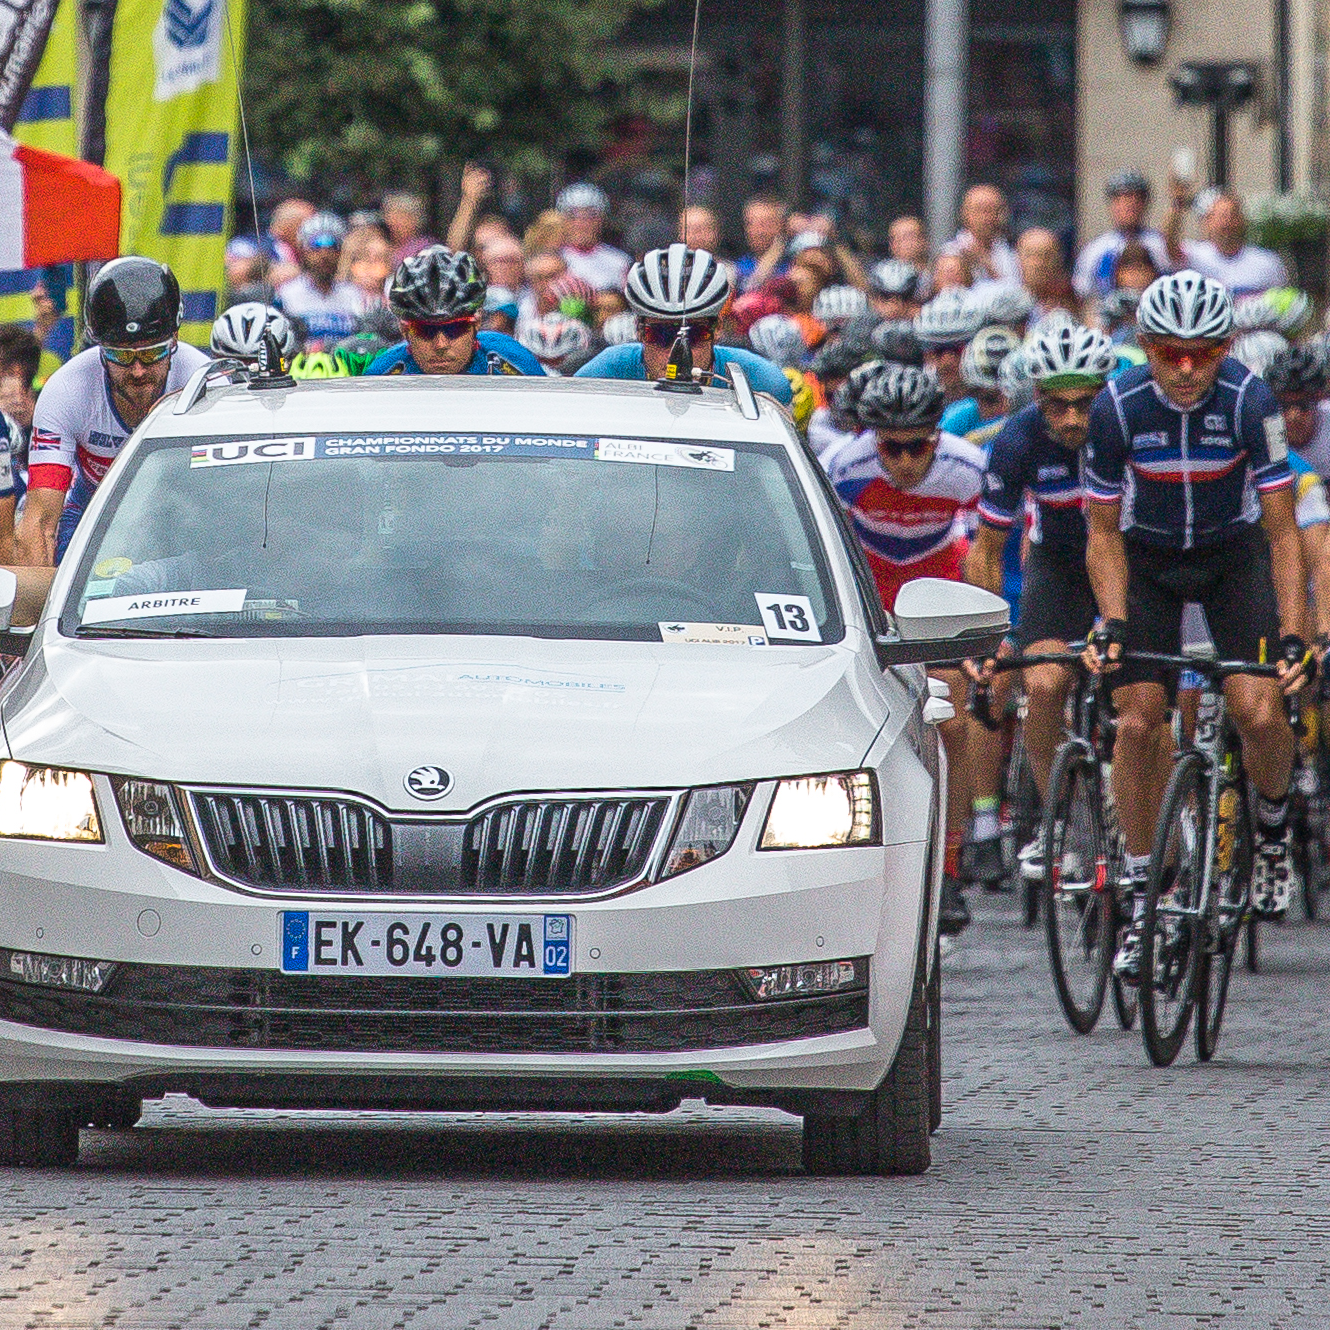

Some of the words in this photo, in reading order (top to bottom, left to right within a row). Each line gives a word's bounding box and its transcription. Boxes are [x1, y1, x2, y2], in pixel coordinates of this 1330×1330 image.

[325, 436, 478, 447] CHAMPIONNATS
[482, 437, 509, 446] DU
[515, 438, 588, 449] MONDE
[604, 442, 644, 451] ALBI
[211, 442, 305, 461] UCI
[325, 446, 383, 456] GRAN
[386, 445, 456, 455] FONDO
[460, 444, 503, 453] 2017
[603, 450, 675, 462] FRANCE
[127, 597, 201, 611] ARBITRE
[766, 603, 810, 632] 13
[458, 673, 626, 691] AUTOMOBILES
[291, 946, 299, 959] F
[313, 921, 536, 968] EK-648-VA
[545, 946, 567, 967] 02
